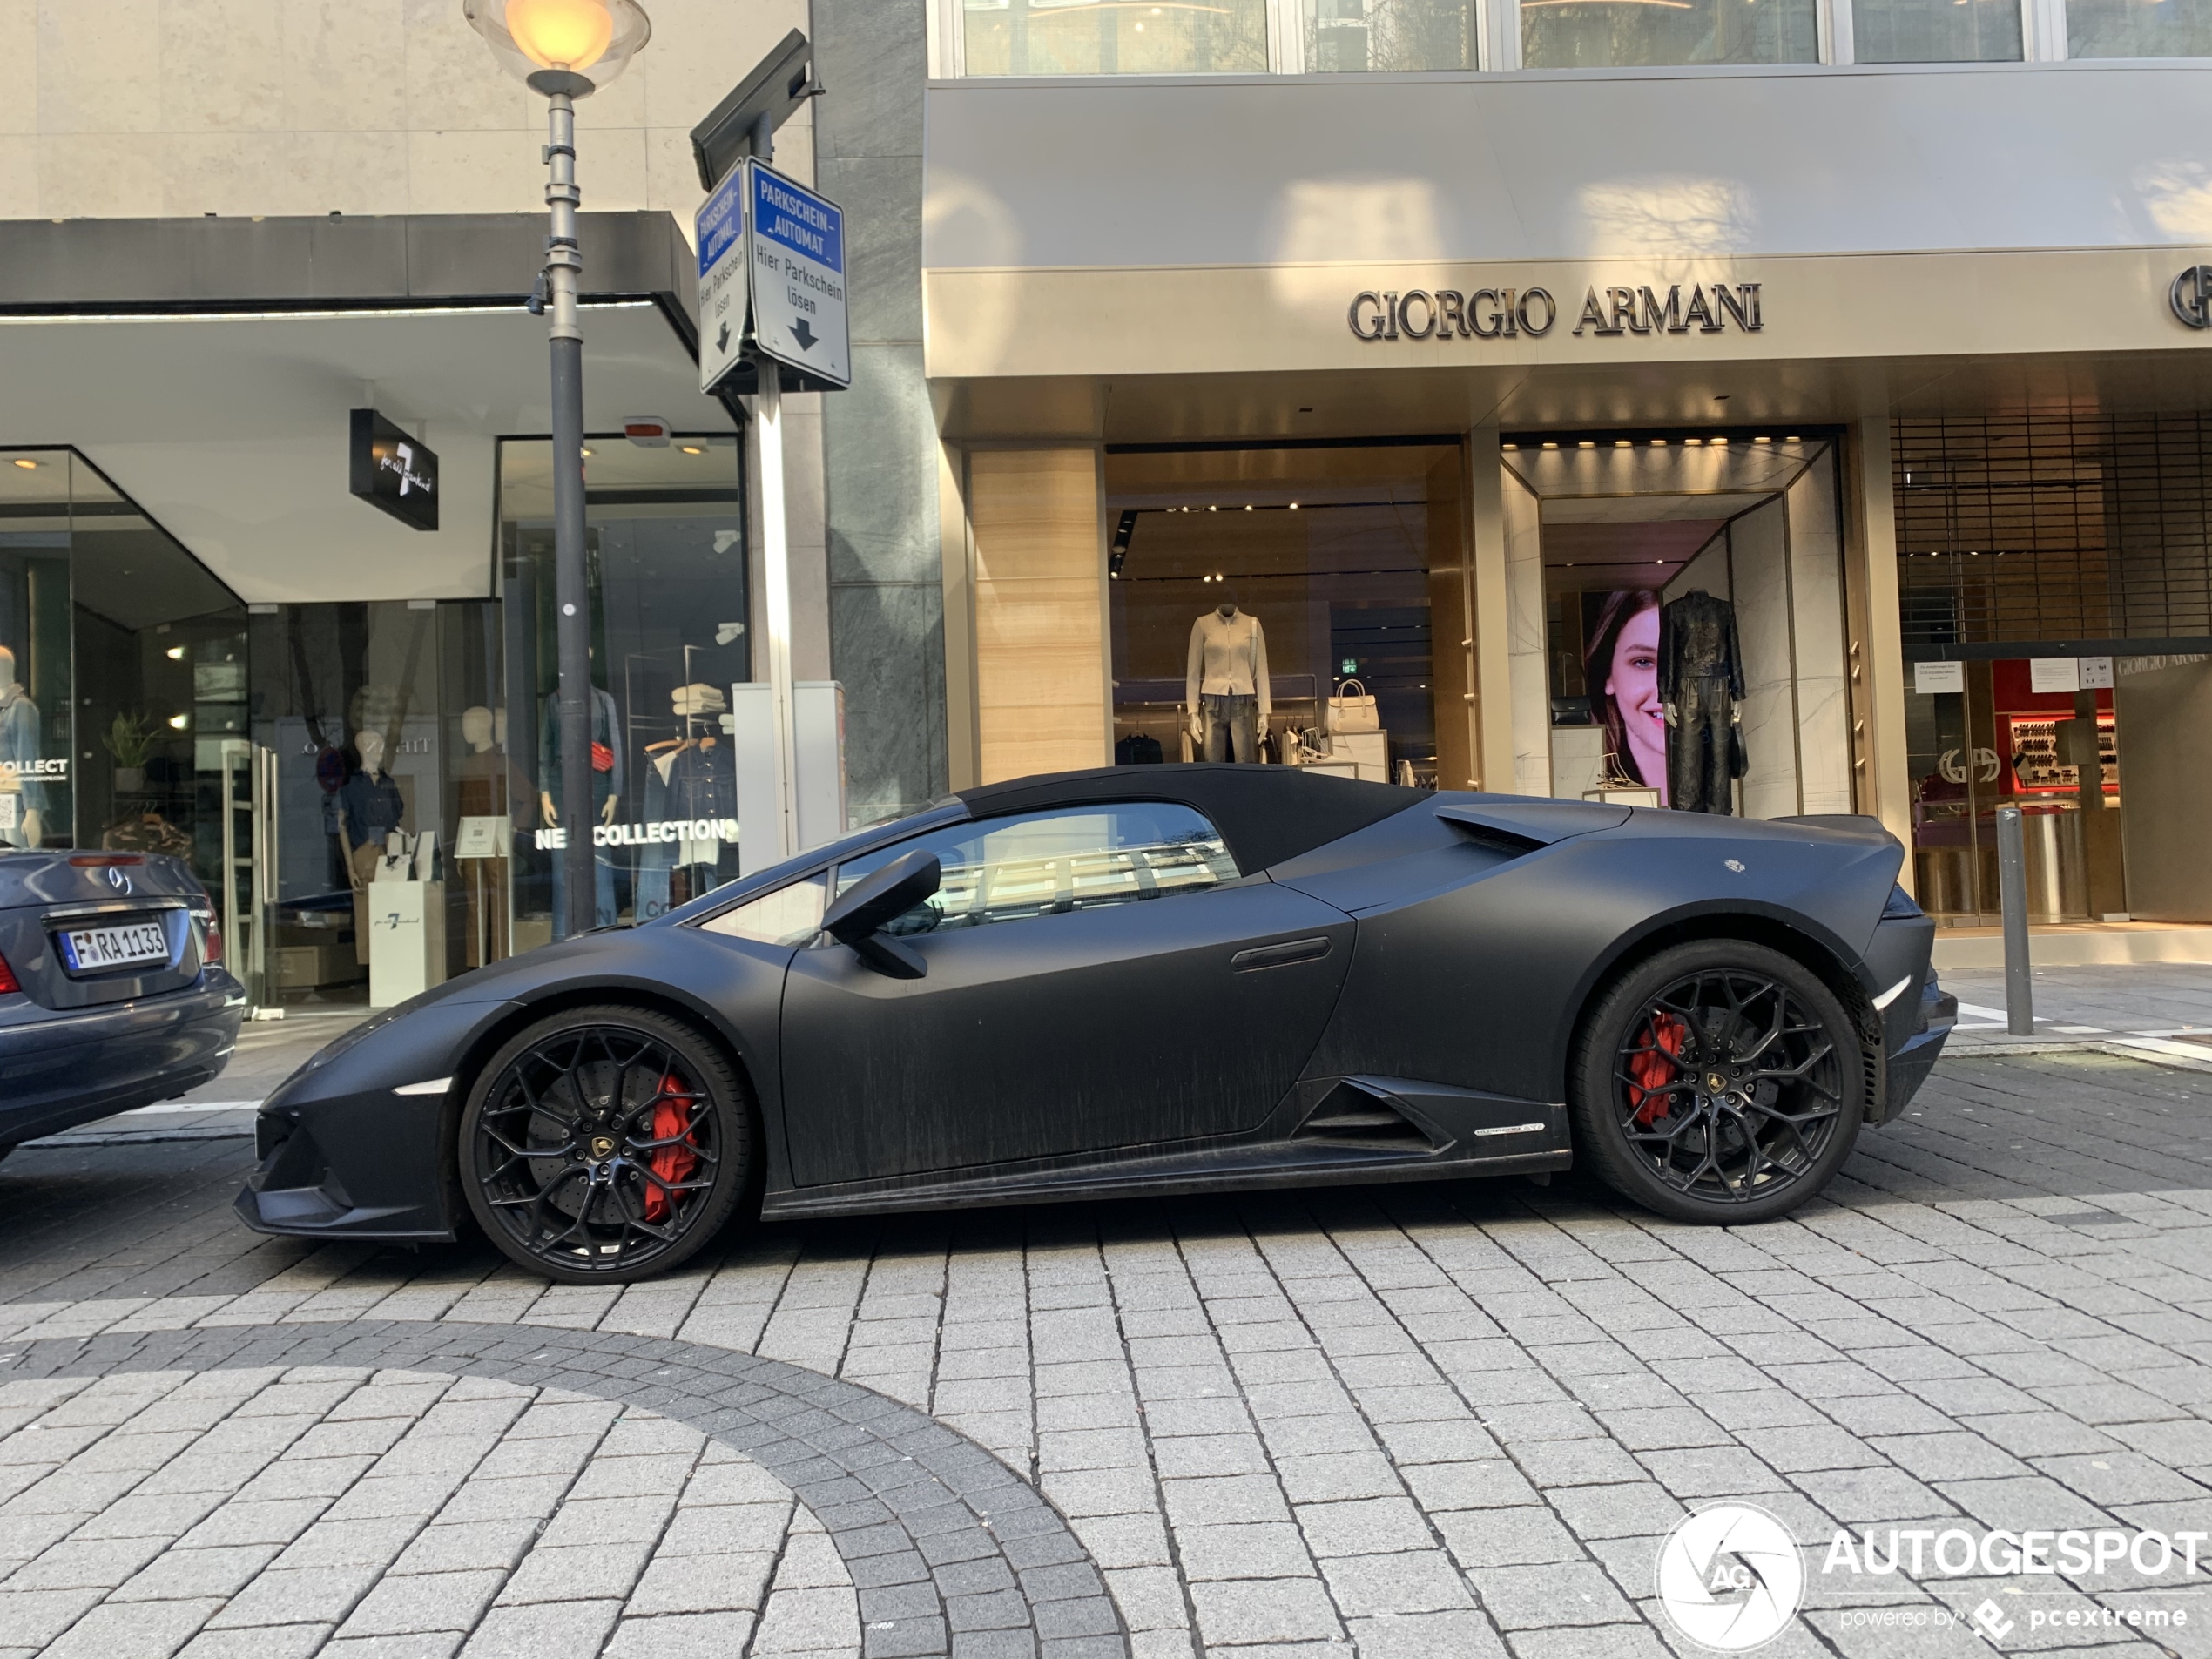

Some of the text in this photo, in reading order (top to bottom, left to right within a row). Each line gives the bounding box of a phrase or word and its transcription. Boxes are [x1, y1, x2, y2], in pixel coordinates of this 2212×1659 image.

[700, 186, 738, 242] PARKSCHEIN-
[760, 179, 835, 233] PARKSCHEIN-
[707, 216, 733, 261] AUTOMAT
[774, 214, 825, 256] AUTOMAT
[700, 248, 743, 308] Hier Parkschein
[756, 244, 843, 302] Hier Parkschein
[715, 293, 730, 319] lösen
[787, 285, 817, 315] lösen
[1348, 281, 1764, 340] GIORGIO ARMANI
[0, 759, 68, 773] OLLECT
[536, 828, 566, 850] NE
[72, 935, 85, 964] F
